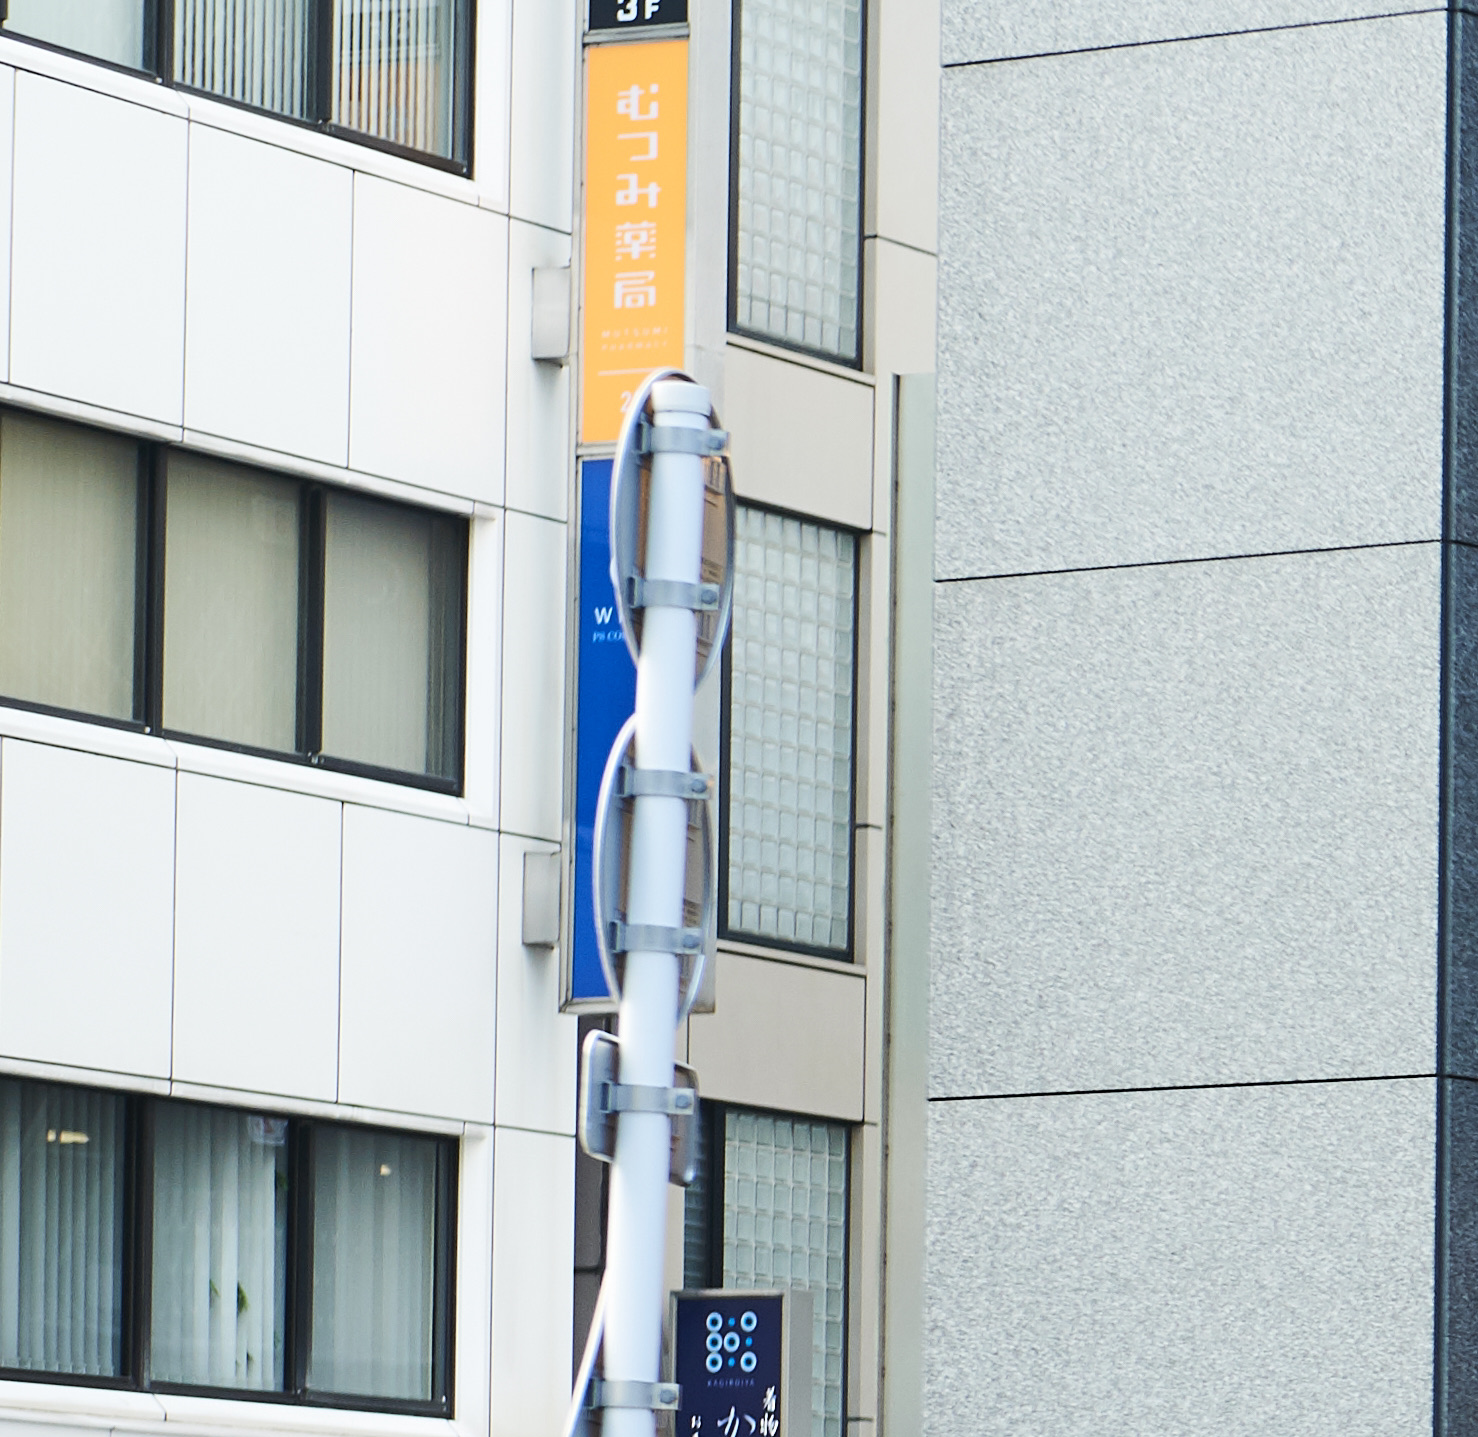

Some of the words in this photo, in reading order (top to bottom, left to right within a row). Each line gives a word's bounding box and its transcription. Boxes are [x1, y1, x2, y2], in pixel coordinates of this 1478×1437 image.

[616, 0, 660, 22] 3F
[613, 82, 662, 310] むつみ薬局
